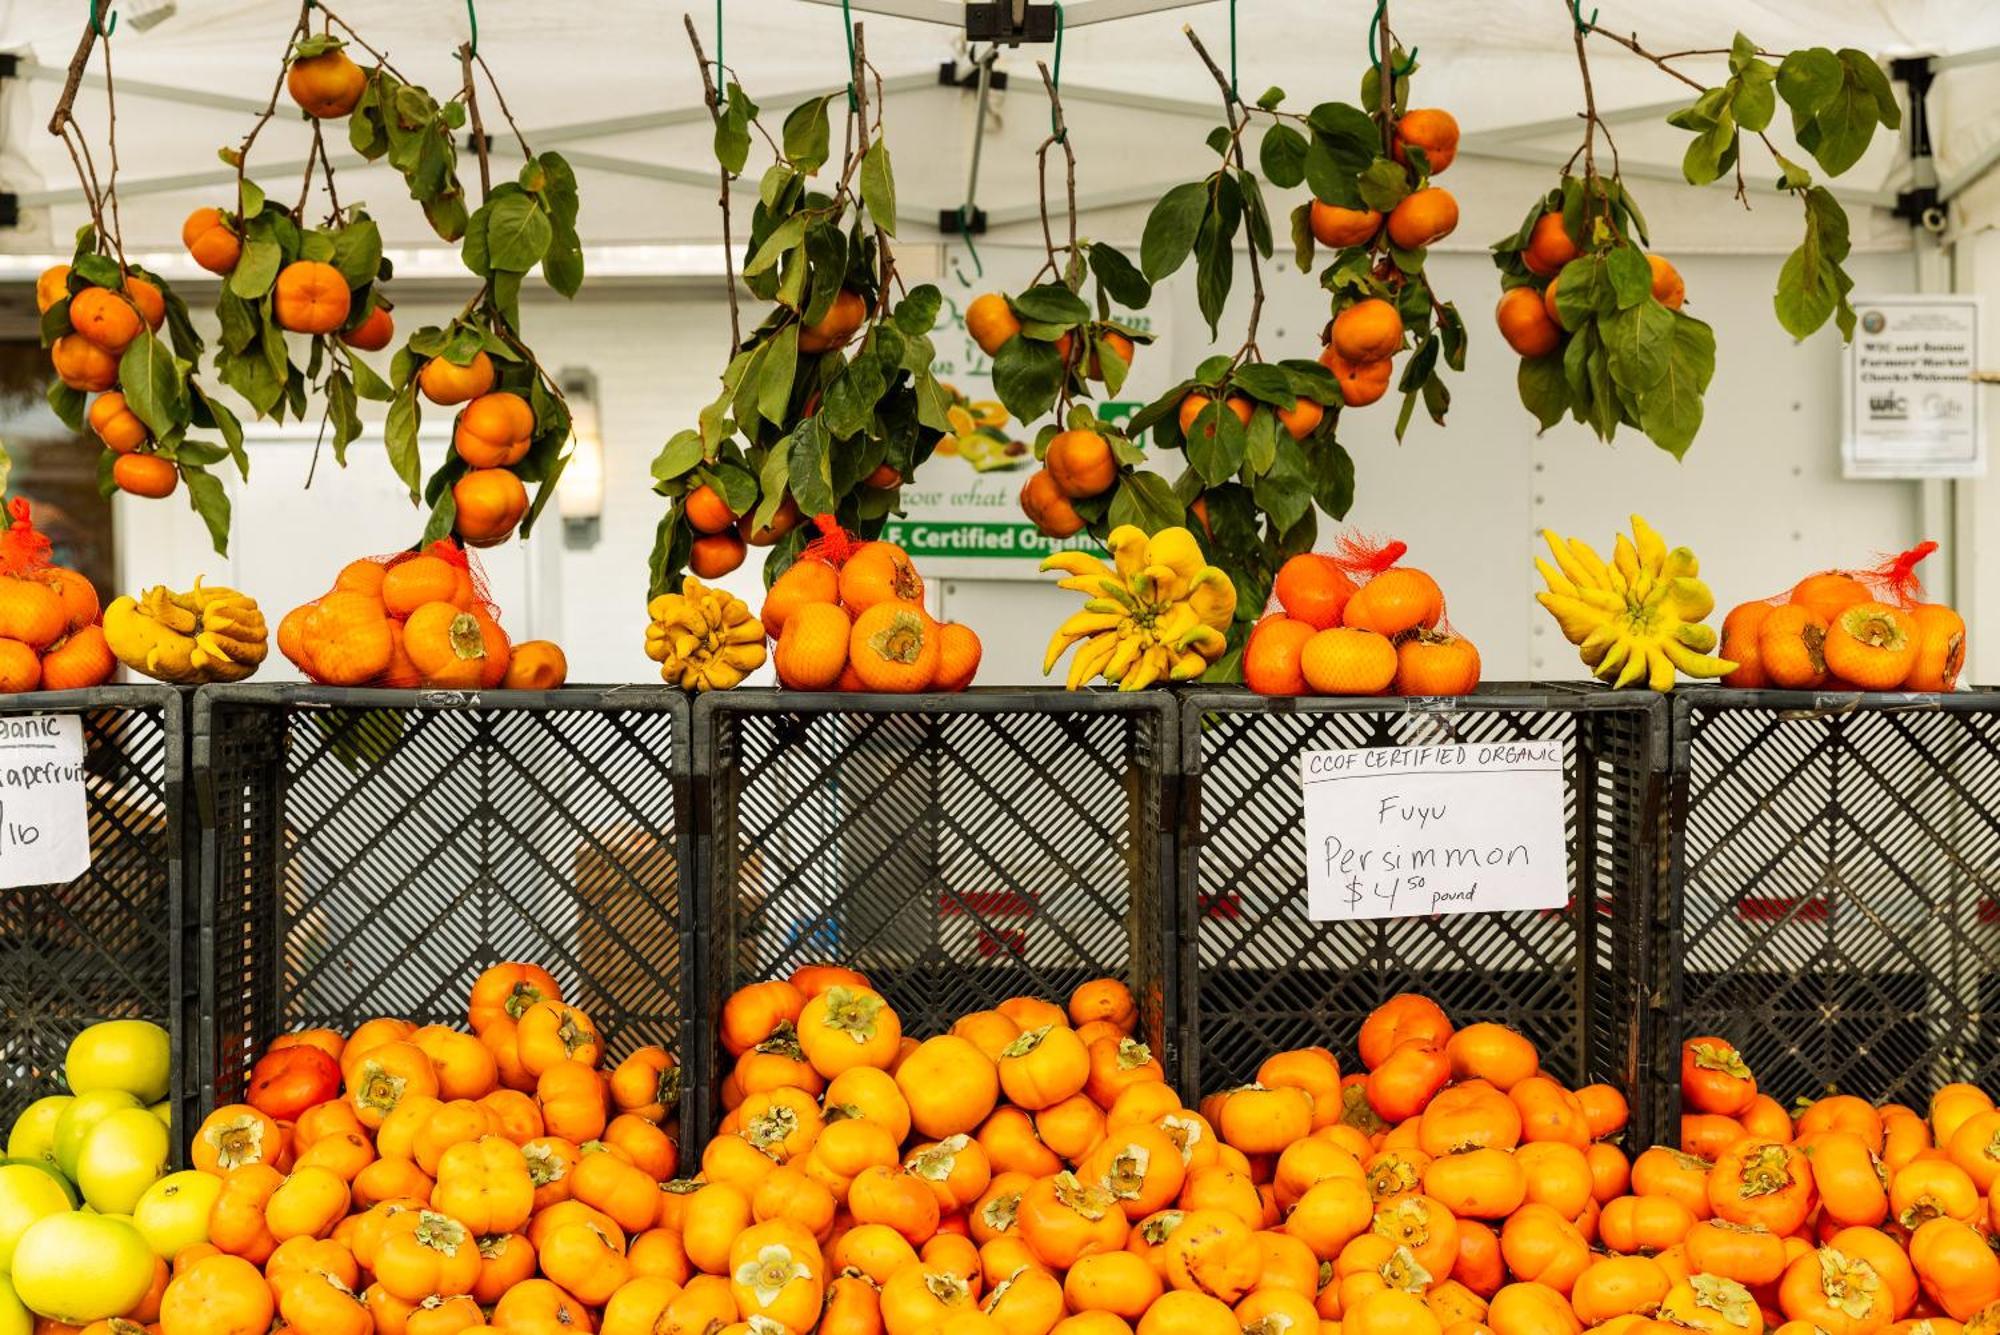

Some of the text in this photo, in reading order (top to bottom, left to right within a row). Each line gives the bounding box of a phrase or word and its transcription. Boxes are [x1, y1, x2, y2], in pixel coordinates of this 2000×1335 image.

[911, 525, 1015, 549] Certified
[1310, 745, 1561, 774] CCOF CERTIFIED ORGANIC
[1378, 795, 1447, 830] Fuyu
[1324, 835, 1529, 878] Persimmon
[1431, 882, 1478, 913] pound
